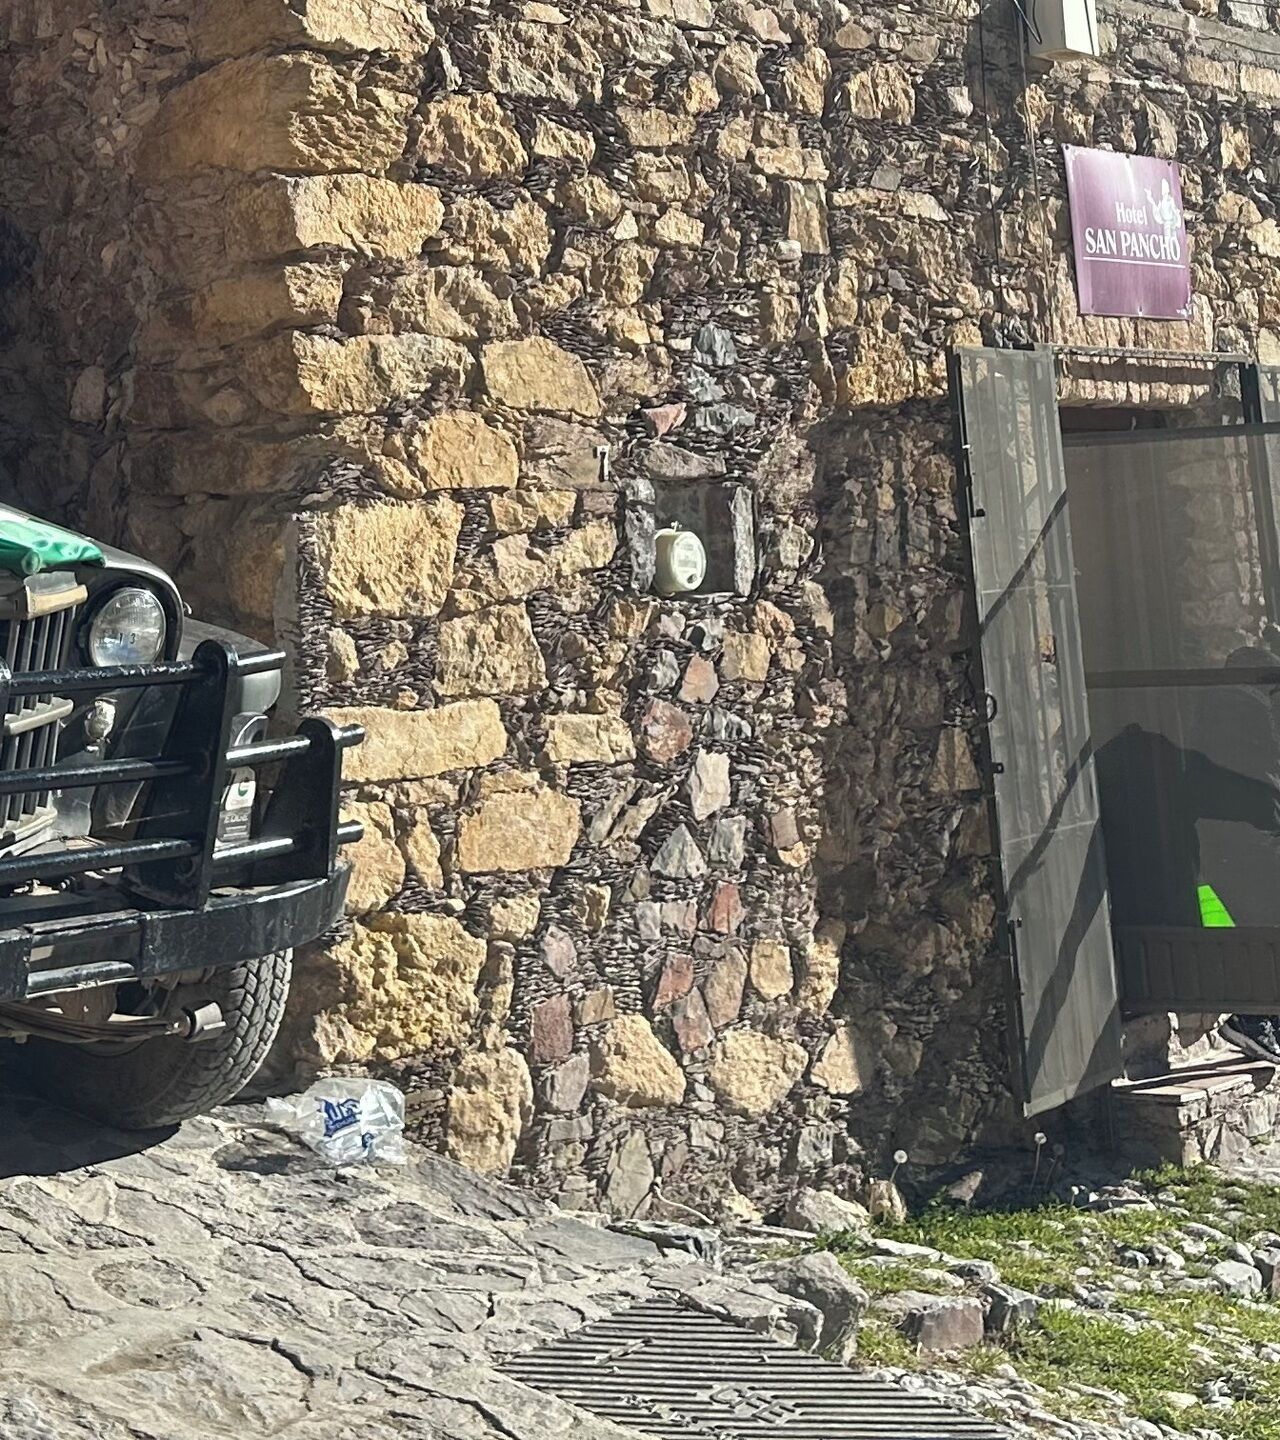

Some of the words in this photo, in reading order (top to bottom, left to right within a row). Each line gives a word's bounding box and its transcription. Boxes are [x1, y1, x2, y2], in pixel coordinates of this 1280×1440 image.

[1115, 201, 1148, 226] Hotel
[1085, 227, 1117, 255] SAN
[1120, 231, 1181, 261] PANCHO
[708, 1385, 797, 1425] CFE
